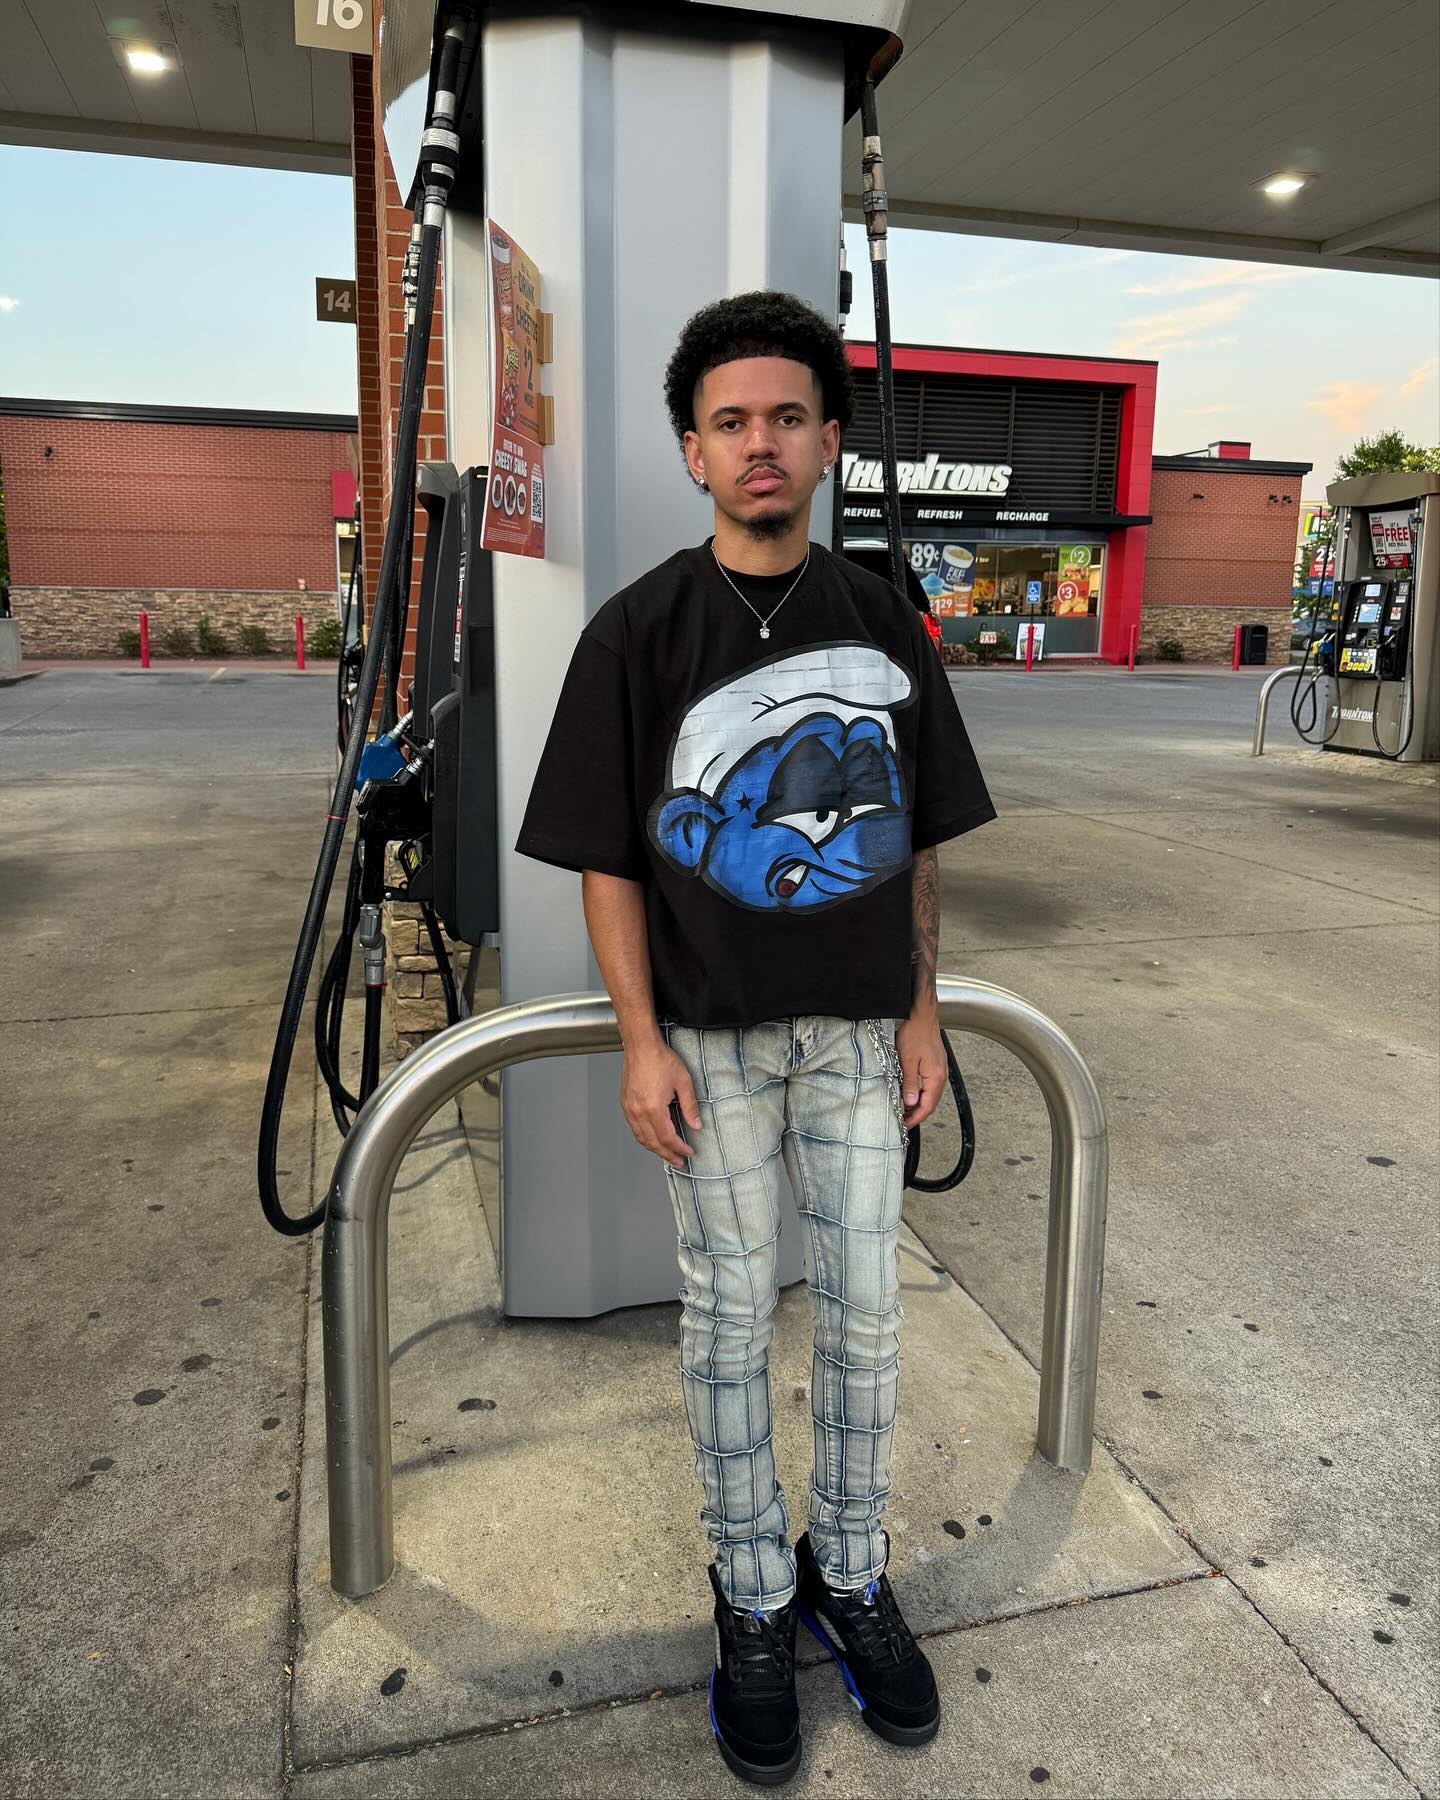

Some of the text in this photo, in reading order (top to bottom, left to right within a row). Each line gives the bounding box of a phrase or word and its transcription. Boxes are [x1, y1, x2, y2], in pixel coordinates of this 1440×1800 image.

[316, 0, 363, 29] 16
[323, 290, 351, 313] 14
[844, 507, 1049, 521] REFUEL REFRESH RECHARGE
[1385, 527, 1409, 541] FREE
[911, 543, 940, 568] 89¢
[1073, 551, 1085, 563] $2
[1062, 587, 1073, 599] $3
